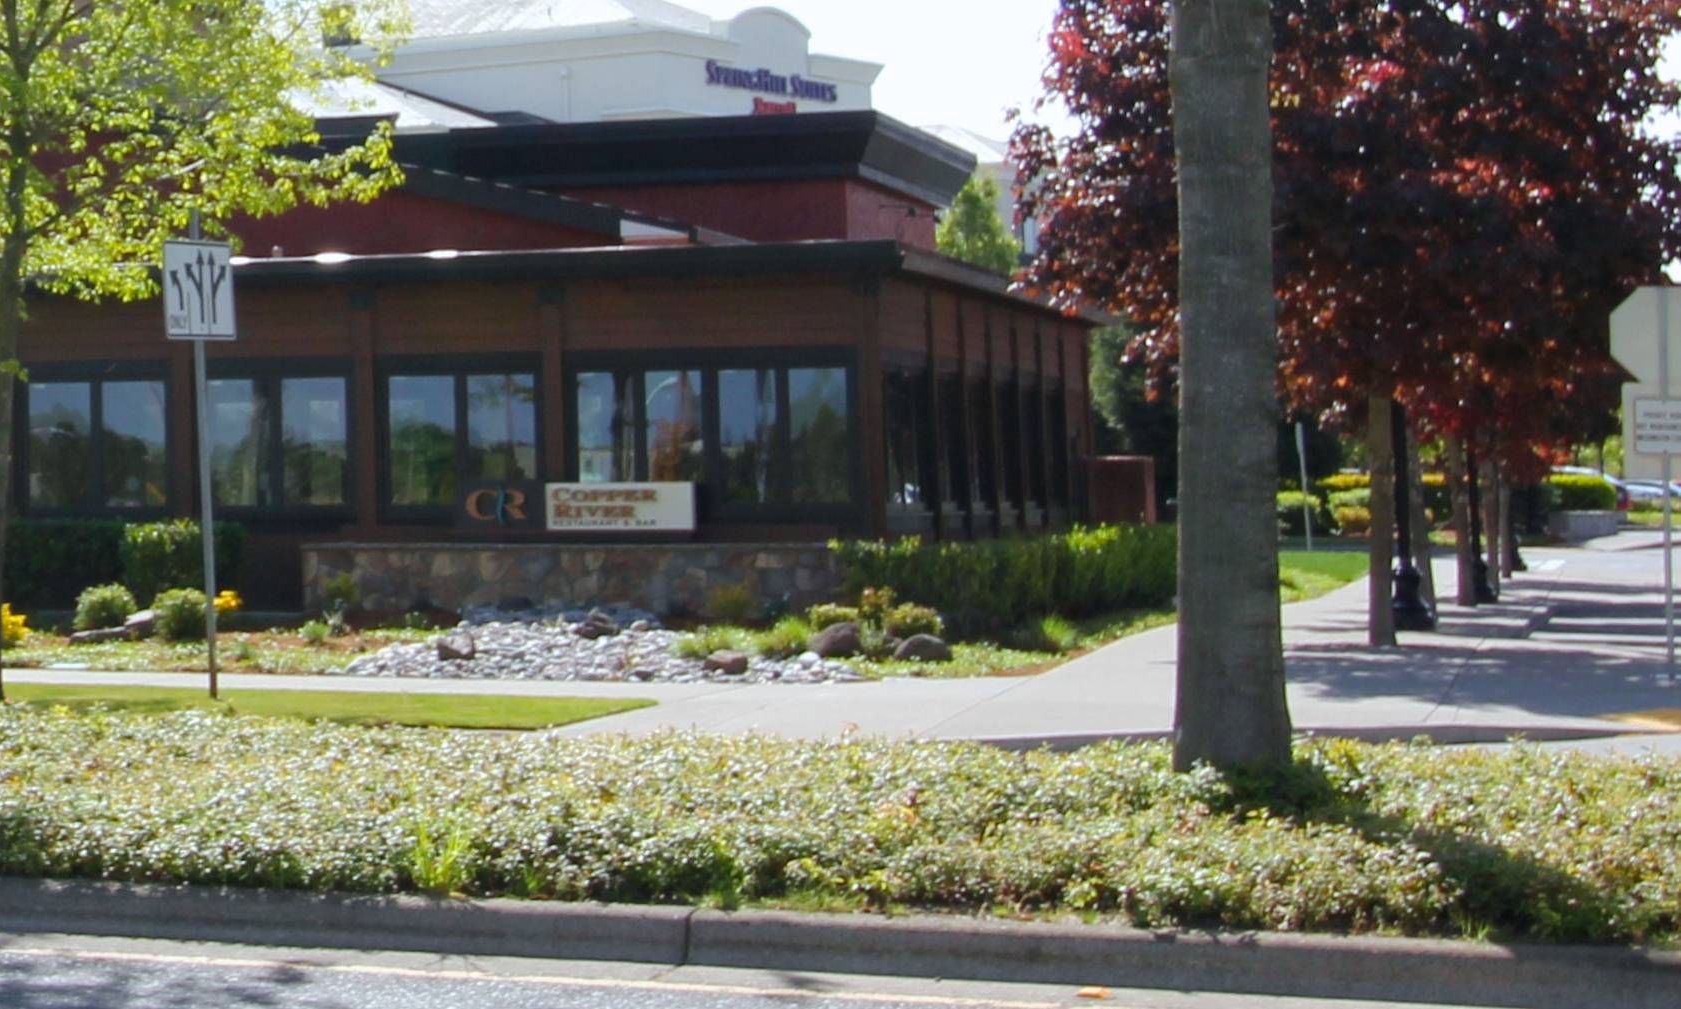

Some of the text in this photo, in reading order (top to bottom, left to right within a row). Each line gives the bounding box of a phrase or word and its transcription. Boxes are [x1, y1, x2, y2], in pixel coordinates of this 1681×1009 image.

[170, 314, 188, 329] ONLY
[552, 487, 657, 503] COPPER
[553, 504, 635, 519] RIVER
[552, 519, 619, 527] RESTAURANT
[635, 519, 657, 527] BAR
